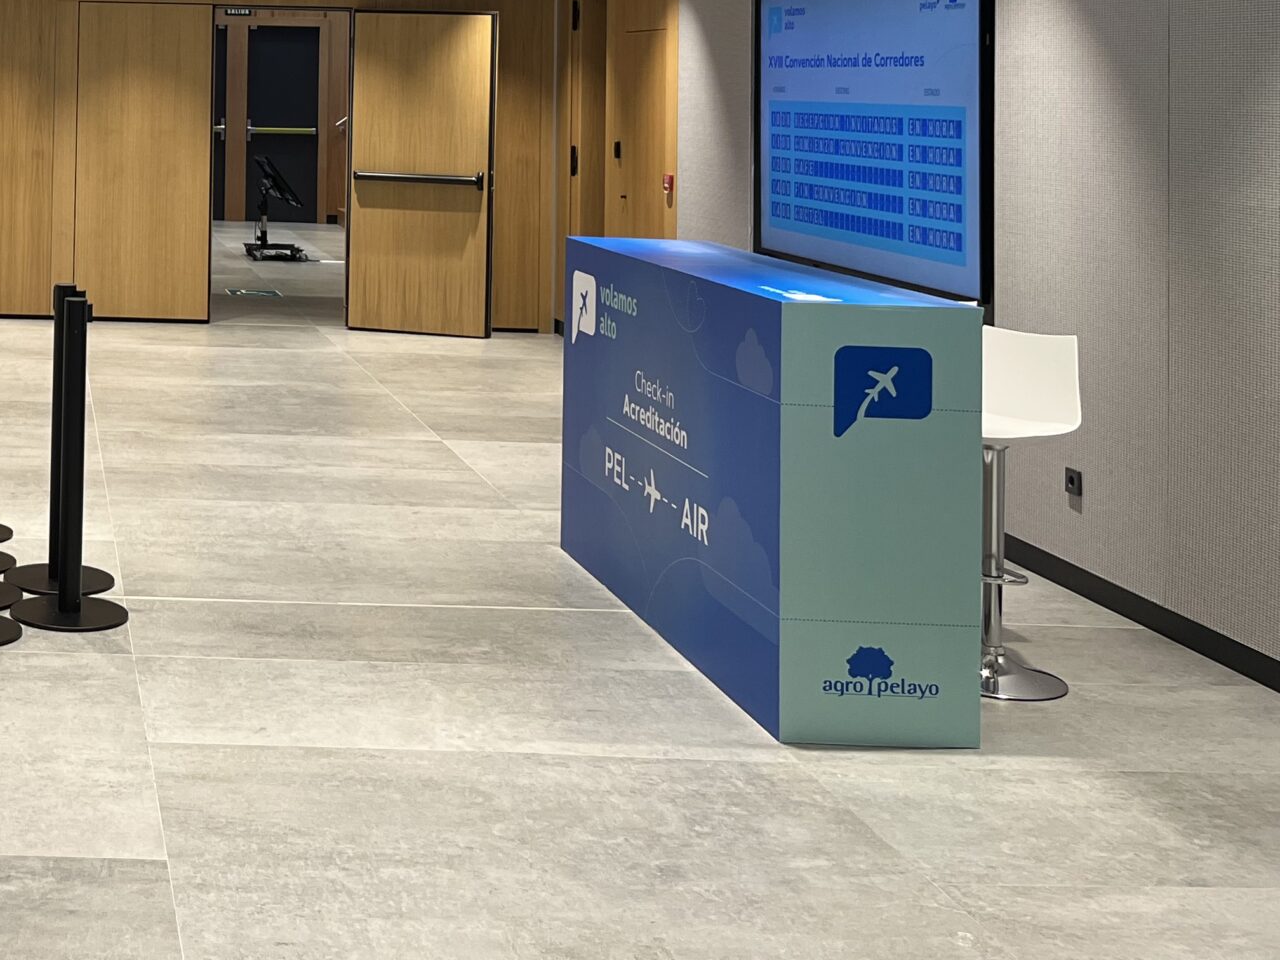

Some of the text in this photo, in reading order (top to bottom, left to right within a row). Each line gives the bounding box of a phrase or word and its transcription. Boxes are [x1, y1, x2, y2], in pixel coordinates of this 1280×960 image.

[785, 54, 825, 68] Convención
[827, 53, 860, 68] Nacional
[862, 53, 872, 67] de
[874, 52, 925, 68] Corredores
[845, 117, 897, 134] INVITADOS
[909, 119, 920, 136] EN
[928, 120, 955, 138] HORA
[909, 145, 920, 162] EN
[928, 147, 955, 165] HORA
[909, 172, 920, 189] EN
[928, 174, 955, 193] HORA
[909, 198, 920, 215] EN
[928, 201, 955, 221] HORA
[909, 225, 920, 242] EN
[928, 229, 955, 249] HORA
[600, 284, 637, 317] volamos
[599, 317, 617, 339] alto
[635, 370, 675, 409] Check-in
[623, 394, 688, 449] Acreditación
[605, 446, 708, 546] PEL AIR
